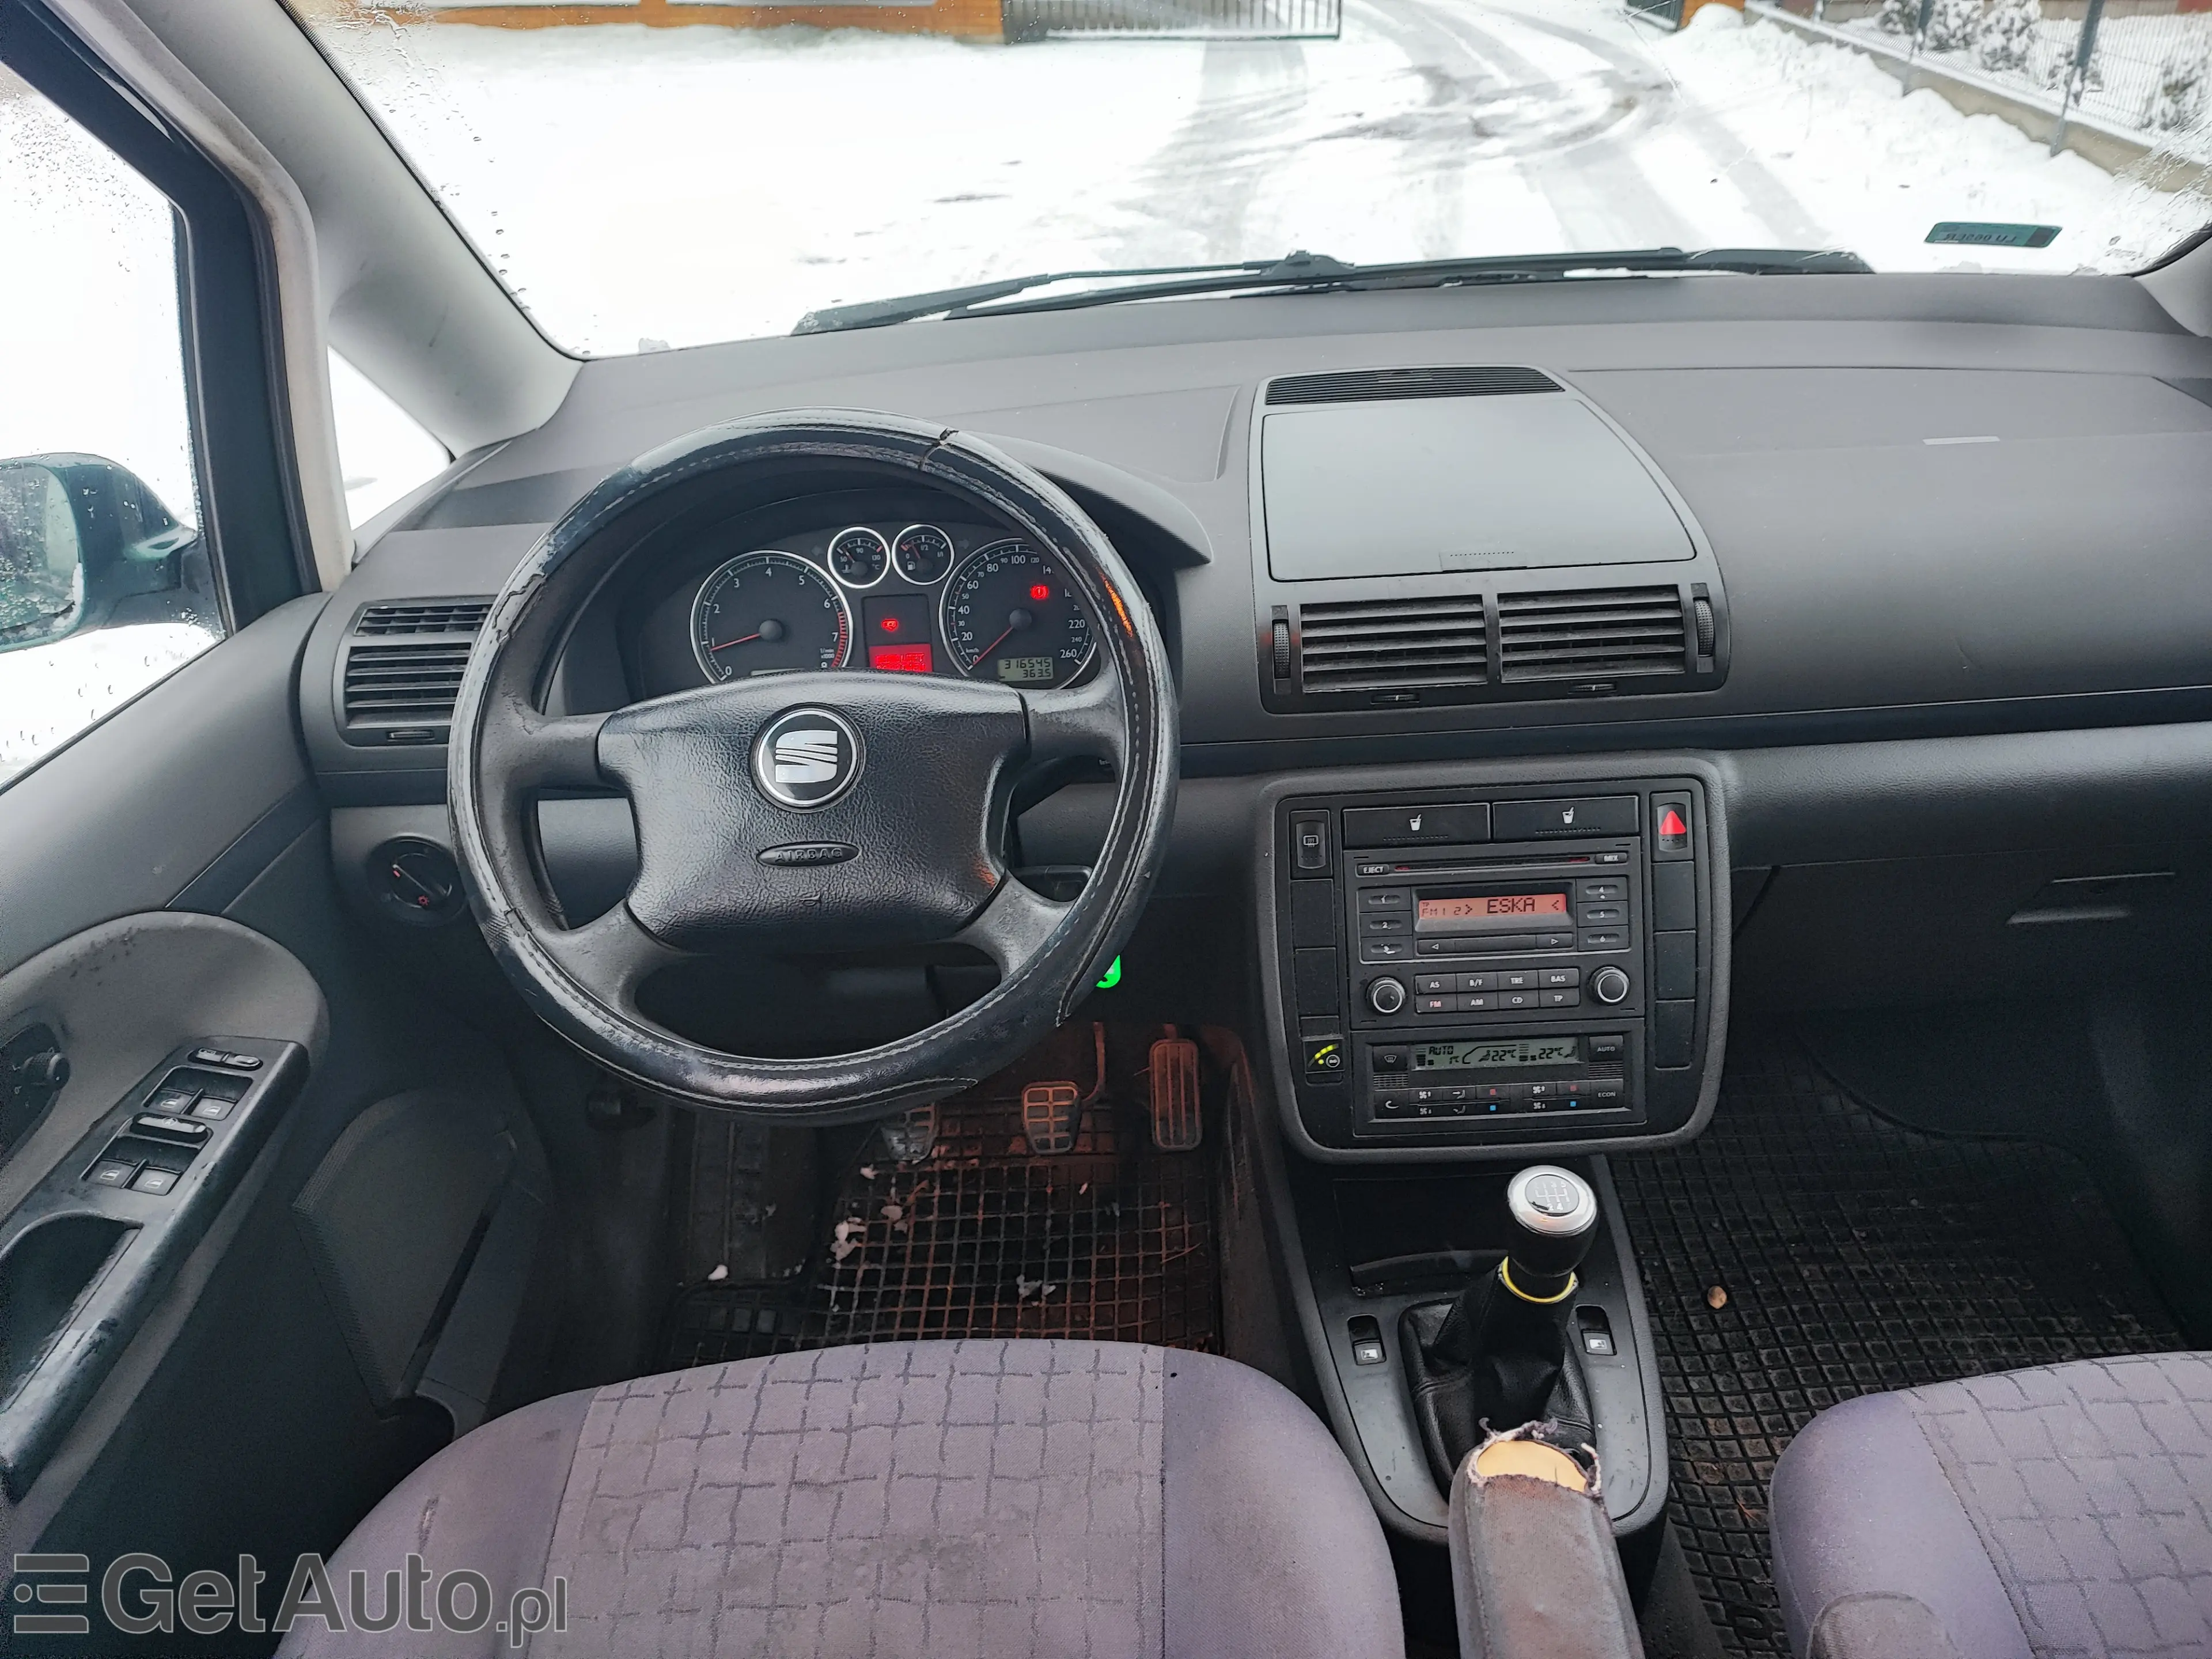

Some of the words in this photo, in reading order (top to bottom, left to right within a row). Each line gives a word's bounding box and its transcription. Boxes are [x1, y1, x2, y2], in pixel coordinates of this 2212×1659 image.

[1011, 555, 1026, 564] 100
[766, 567, 772, 577] 4
[986, 563, 999, 572] 80
[734, 578, 740, 588] 3
[799, 575, 805, 585] 5
[967, 581, 979, 589] 60
[824, 599, 831, 608] 6
[714, 605, 720, 613] 2
[957, 605, 970, 615] 40
[1068, 620, 1085, 628] 220
[832, 632, 839, 642] 7
[961, 632, 973, 641] 20
[1060, 649, 1077, 658] 260
[1005, 658, 1051, 669] 316545
[725, 666, 732, 675] 0
[775, 849, 843, 863] AIRBAG
[1487, 897, 1535, 914] ESKA
[1429, 1046, 1454, 1055] AUTO
